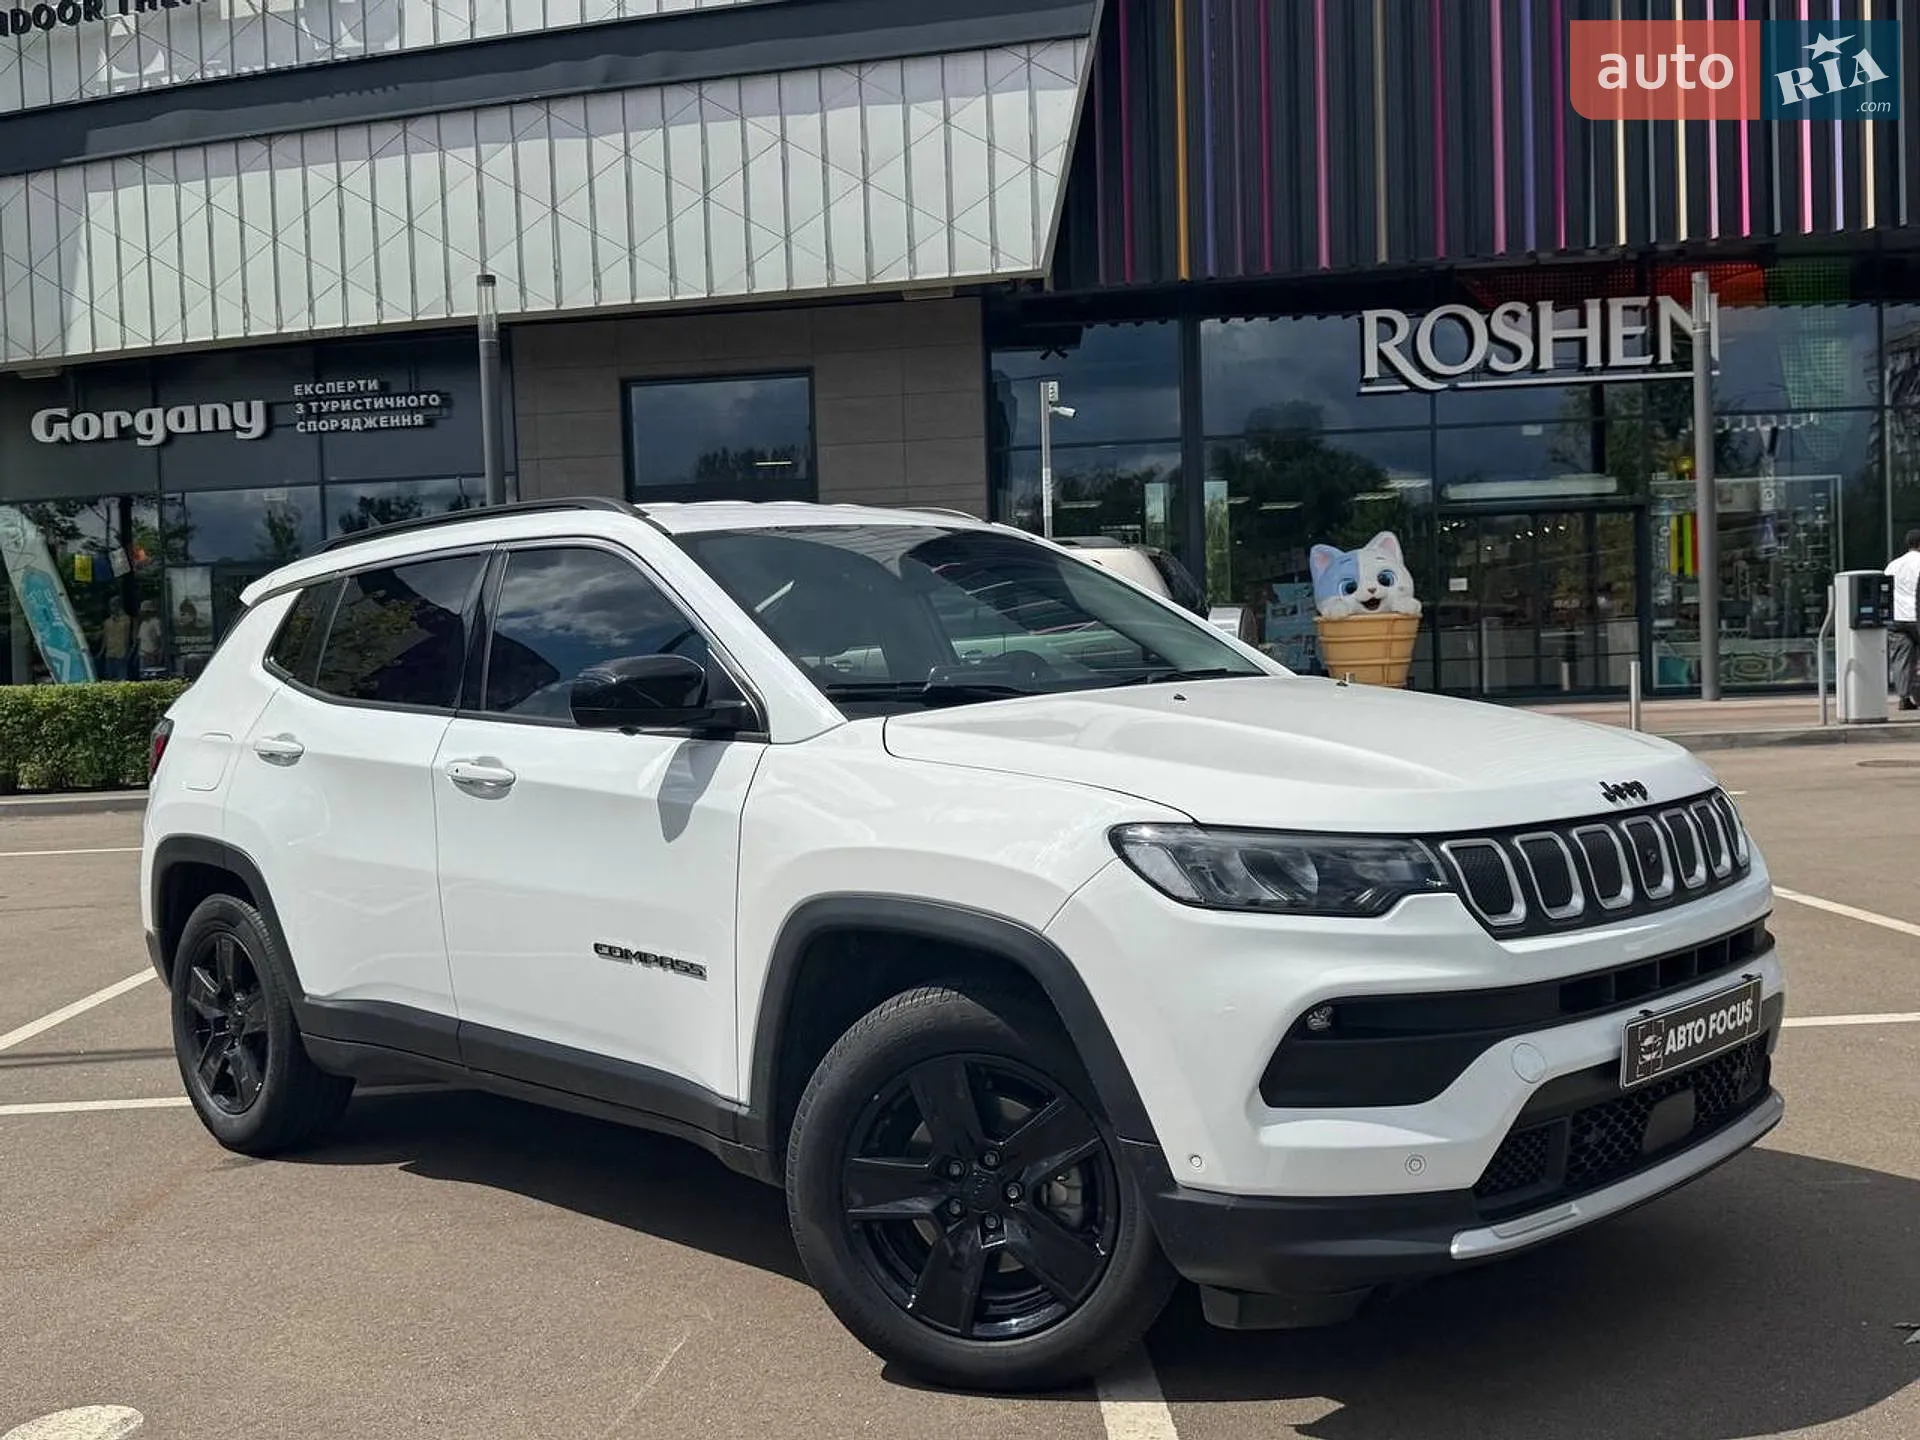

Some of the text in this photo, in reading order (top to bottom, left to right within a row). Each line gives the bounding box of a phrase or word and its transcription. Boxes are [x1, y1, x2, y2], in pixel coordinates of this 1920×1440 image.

[1361, 293, 1720, 390] ROSHEN
[293, 379, 380, 396] ЕКСПЕРТИ
[308, 394, 441, 414] ТУРИСТИЧНОГО
[31, 400, 267, 446] Gorgany
[296, 414, 425, 433] СПОРЯДЖЕННЯ
[1599, 780, 1648, 802] Jeep
[593, 942, 708, 981] COMPASS
[1708, 998, 1753, 1039] FOCUS
